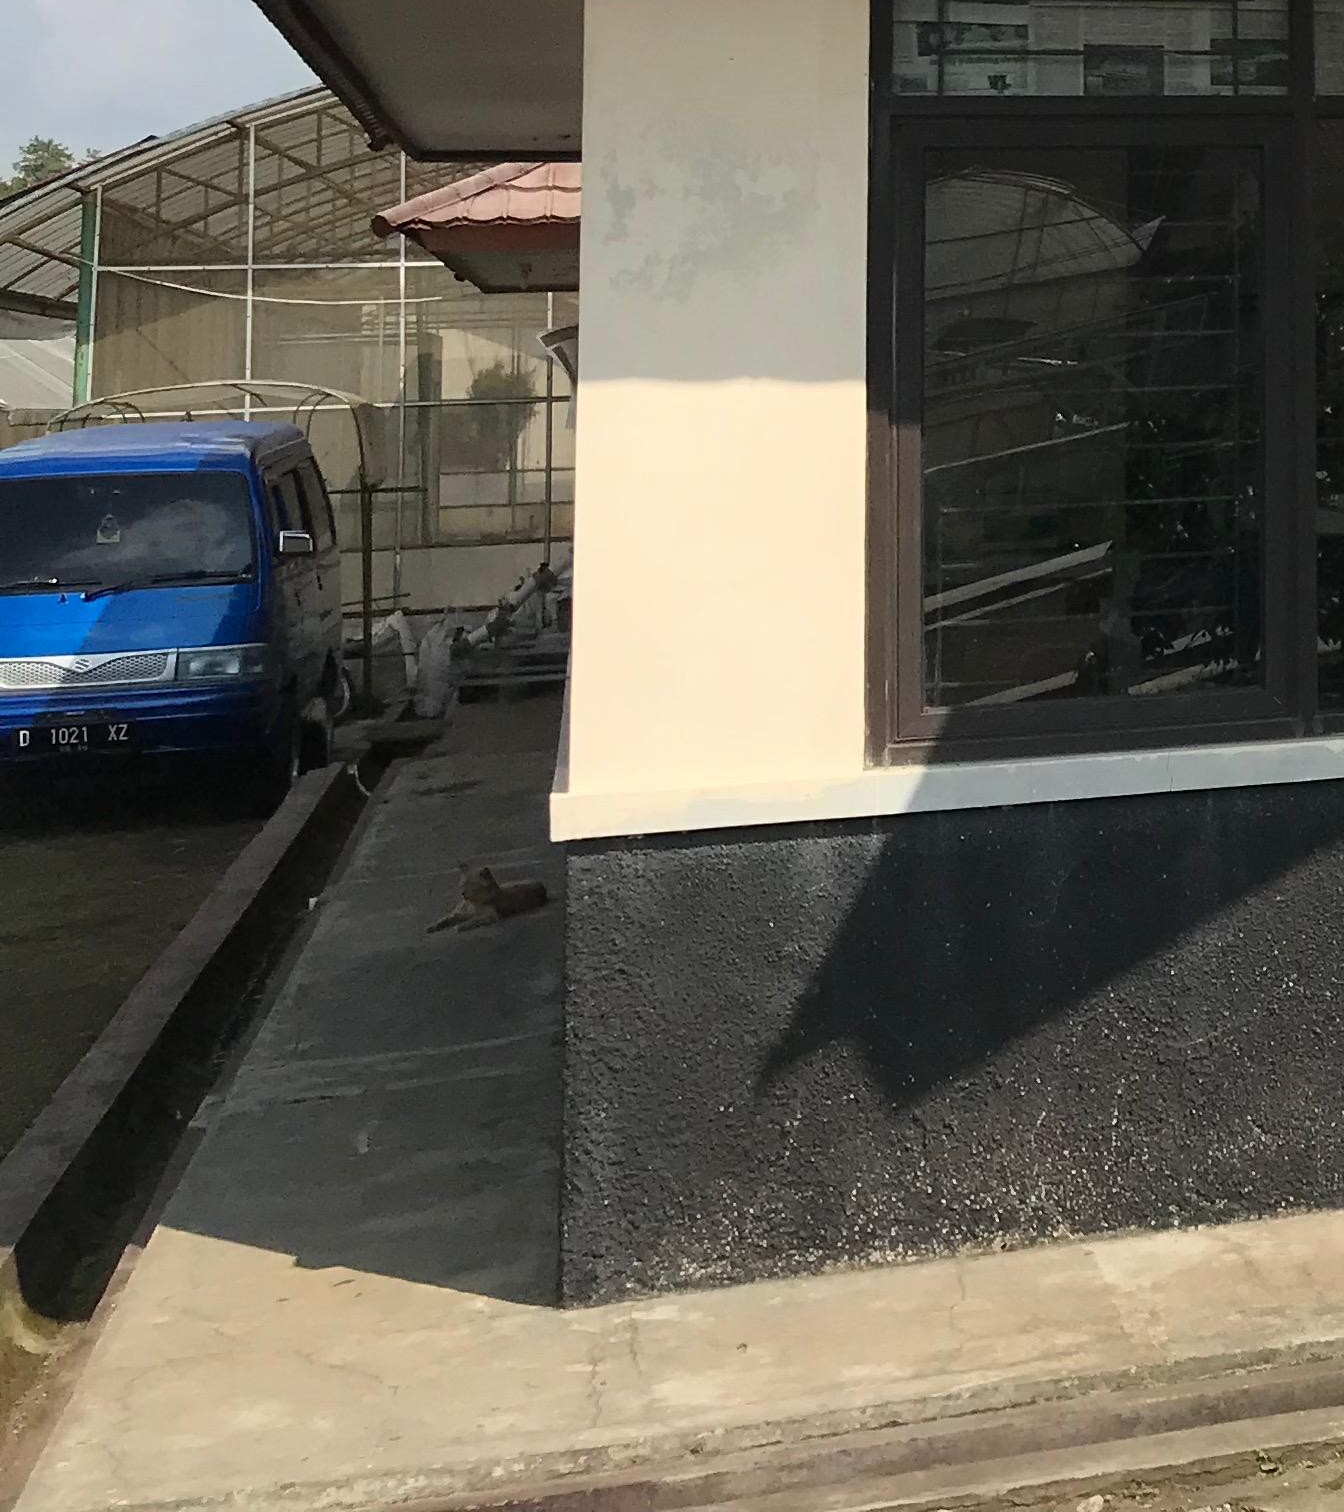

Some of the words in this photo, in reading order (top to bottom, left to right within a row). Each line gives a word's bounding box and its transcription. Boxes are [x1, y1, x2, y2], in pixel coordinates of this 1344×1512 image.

[19, 730, 30, 747] D
[50, 727, 88, 744] 1021
[107, 723, 129, 741] XZ
